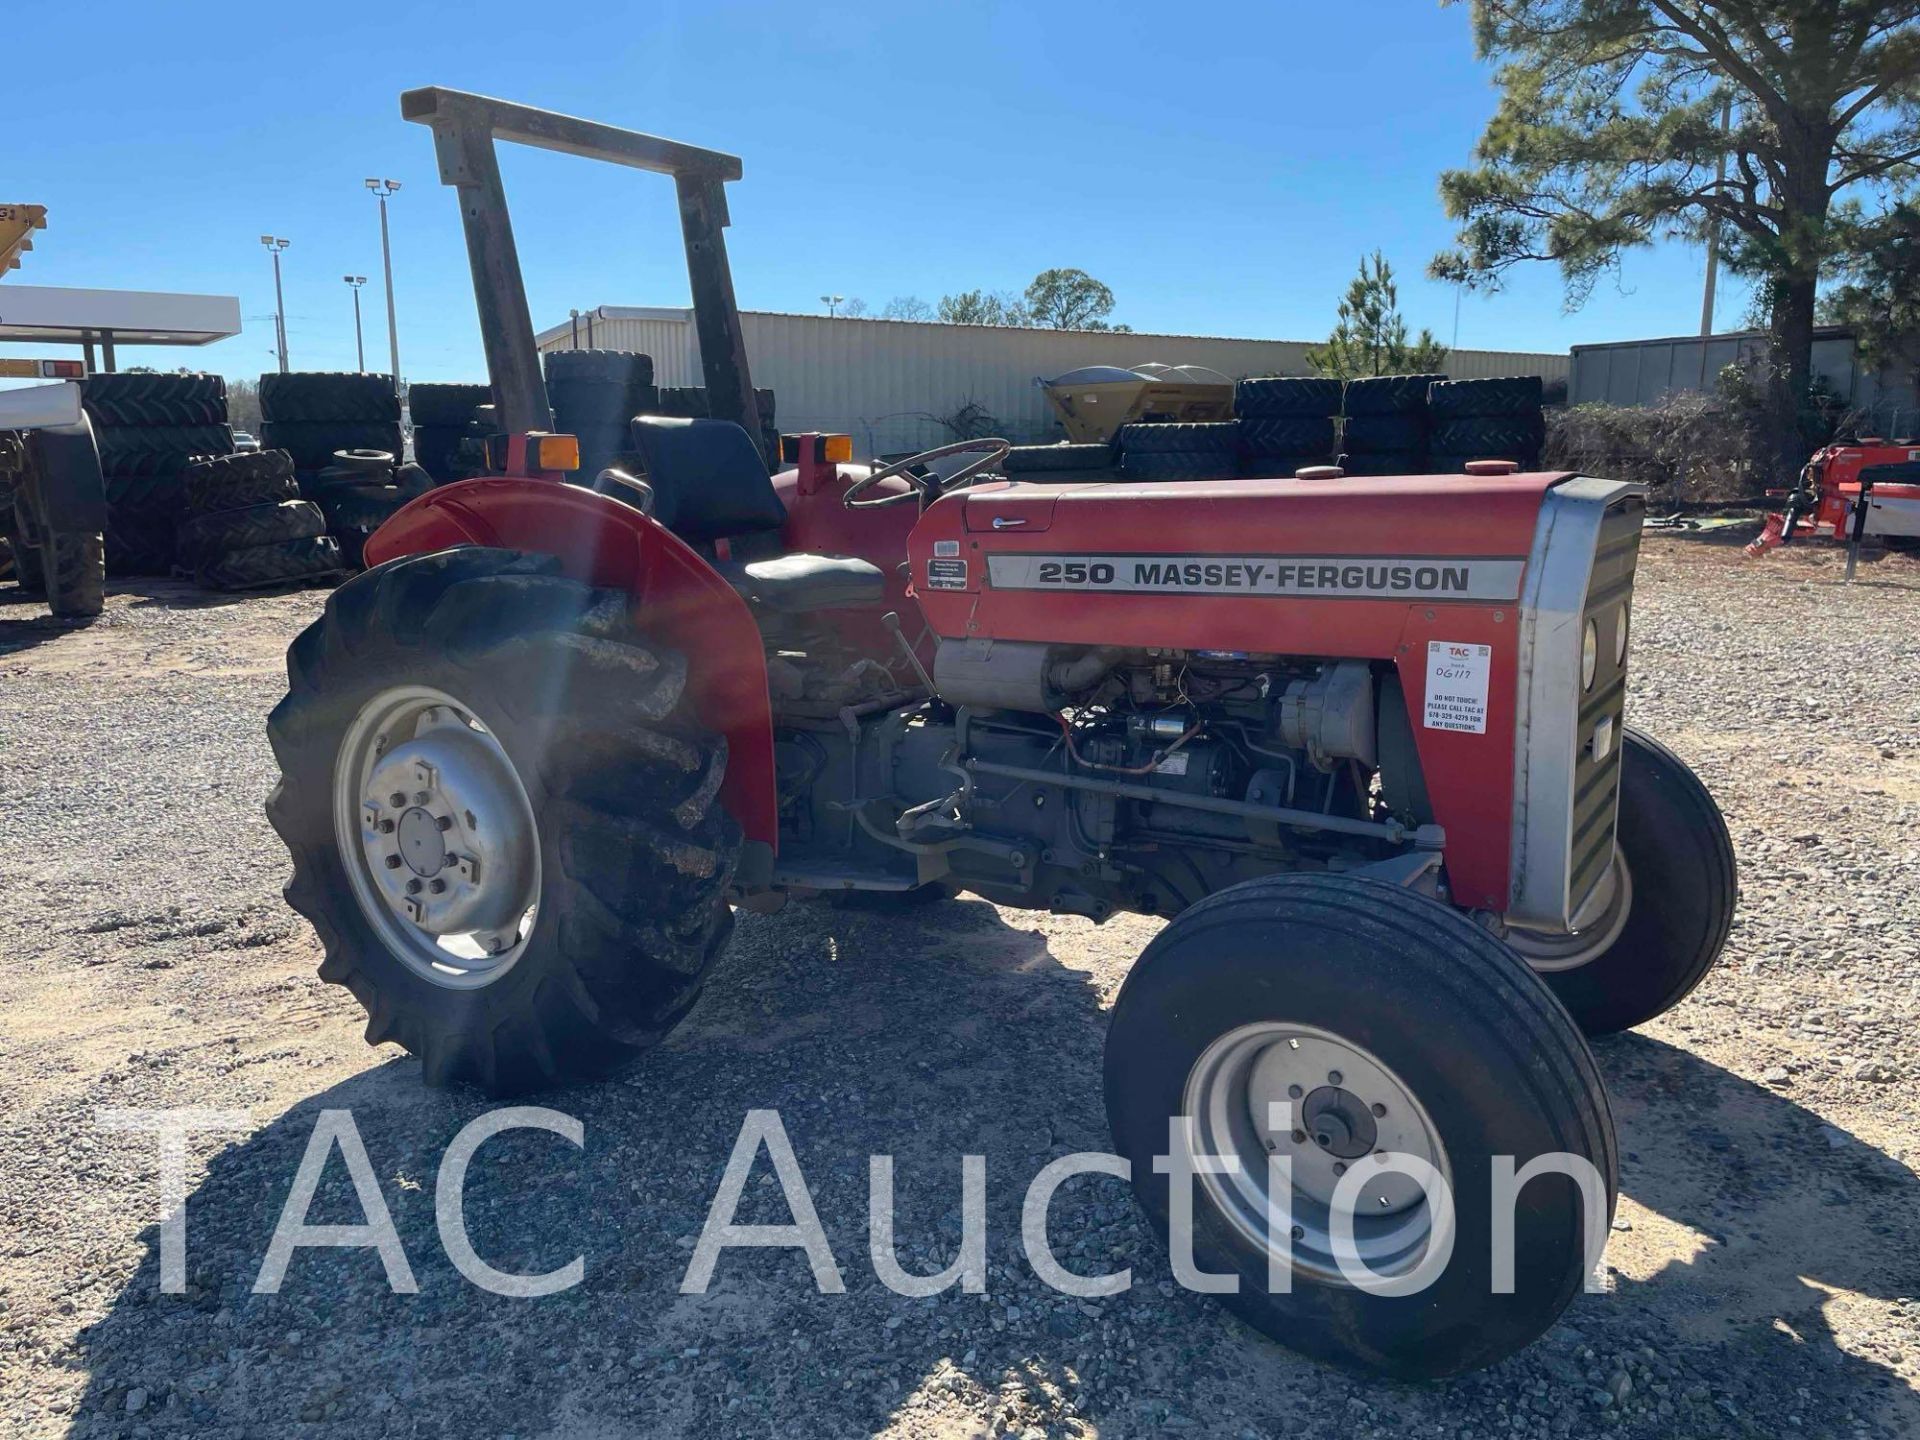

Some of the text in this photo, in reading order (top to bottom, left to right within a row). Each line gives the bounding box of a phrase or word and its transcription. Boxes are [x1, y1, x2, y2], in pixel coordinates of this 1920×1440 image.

[1039, 563, 1470, 591] 250 MASSEY-FERGUSON
[1449, 647, 1469, 657] TAC
